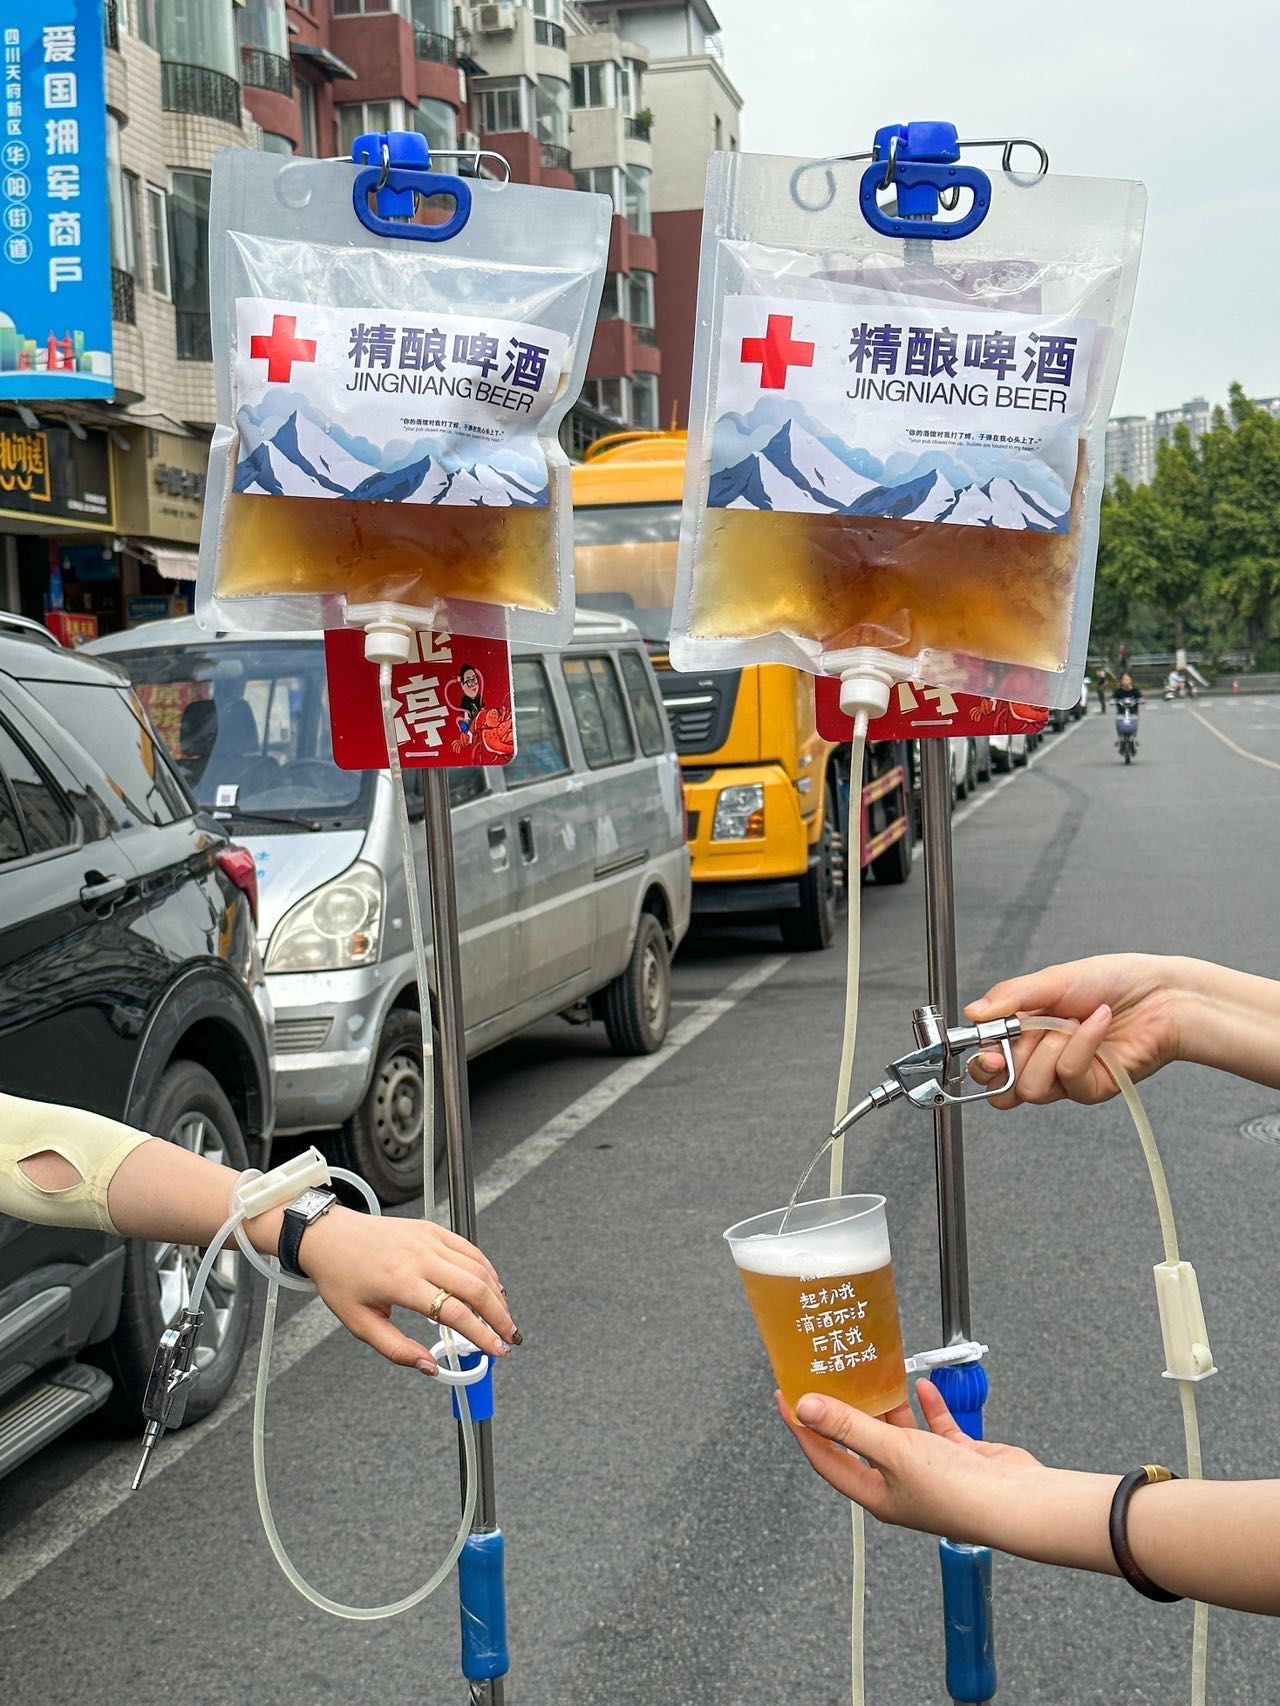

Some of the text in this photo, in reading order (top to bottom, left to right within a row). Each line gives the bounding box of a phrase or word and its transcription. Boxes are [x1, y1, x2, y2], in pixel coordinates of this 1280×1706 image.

[42, 25, 83, 293] 爱国拥军商户
[348, 322, 550, 393] 精酿啤酒
[847, 322, 1079, 388] 精酿啤酒
[346, 372, 535, 414] JINGNIANG BEER
[846, 377, 1067, 414] JINGNIANG BEER
[799, 1282, 856, 1310] 起初我
[795, 1301, 868, 1334] 滴酒不沾
[812, 1325, 864, 1354] 后来我
